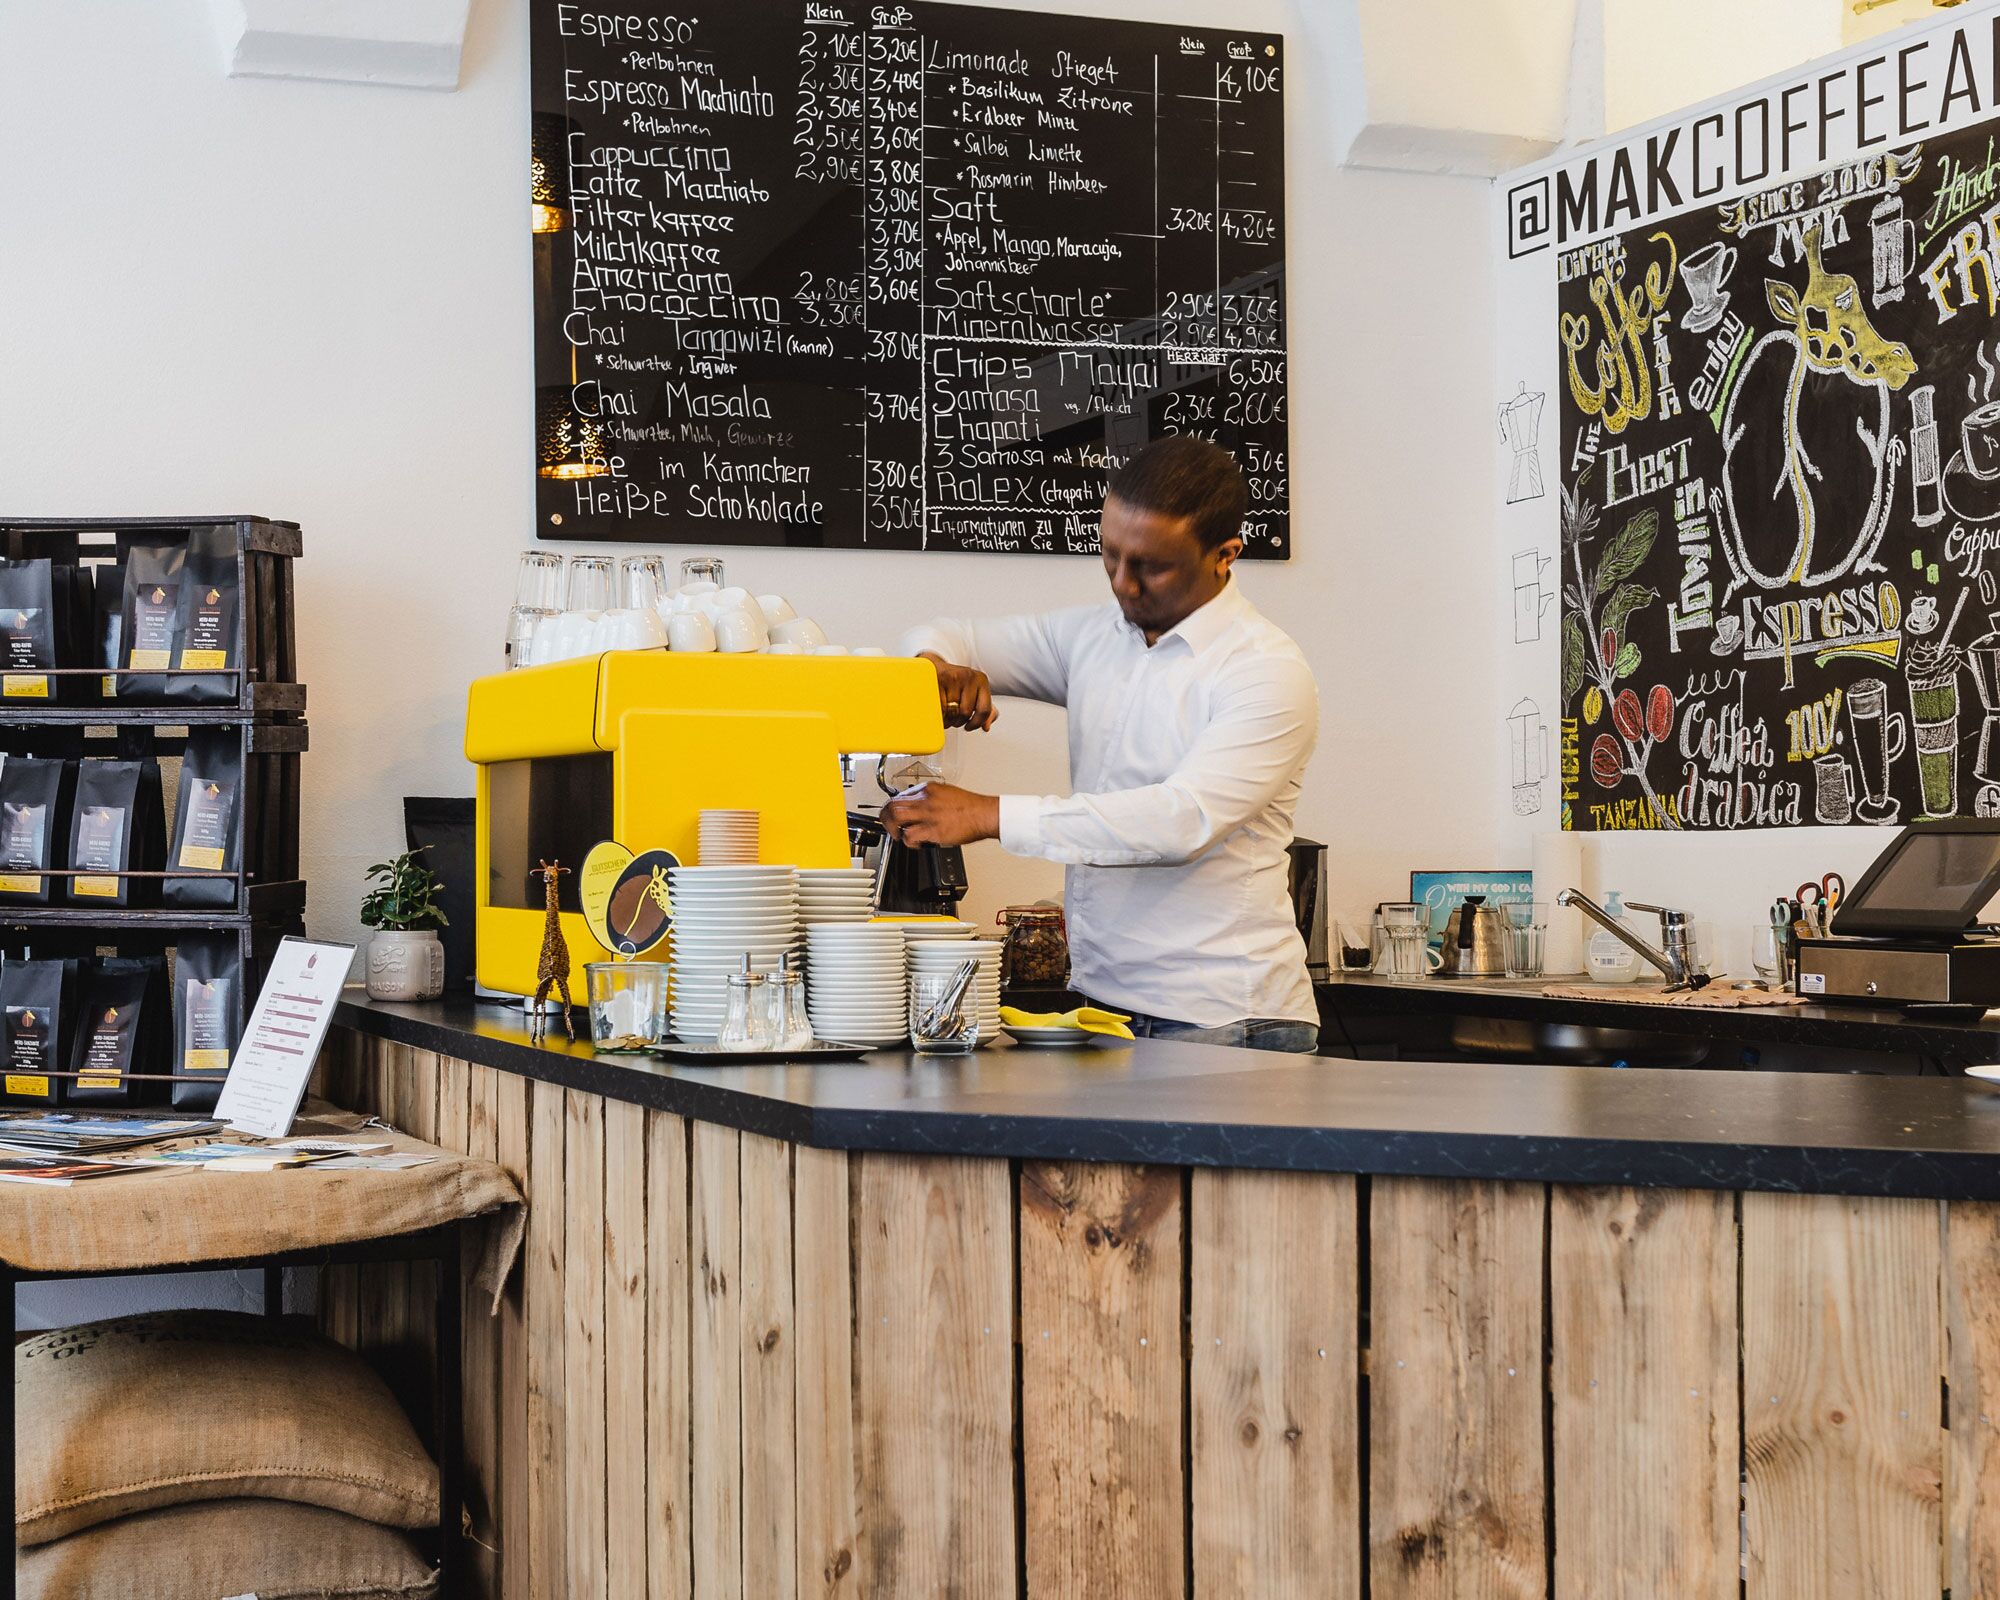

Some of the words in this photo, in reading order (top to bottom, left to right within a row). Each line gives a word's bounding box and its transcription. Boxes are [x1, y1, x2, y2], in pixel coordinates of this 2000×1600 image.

[806, 2, 844, 20] Klein
[798, 31, 862, 59] 2,10€
[868, 36, 920, 64] 3,20€
[928, 39, 1029, 77] Limonade
[1179, 36, 1206, 50] Klein
[566, 69, 670, 114] Espresso
[798, 59, 864, 92] 2,30€
[868, 67, 922, 93] 3,40€
[1218, 65, 1280, 98] 4,10€
[796, 90, 864, 120] 2,30€
[868, 96, 919, 122] 3,40€
[1056, 86, 1134, 116] Zitrone
[793, 118, 863, 151] 2,50€
[870, 125, 922, 154] 3,60€
[1028, 138, 1084, 163] Limette
[1508, 16, 2000, 260] @MAKCOFFEEA
[568, 133, 732, 173] Cappuccino
[795, 151, 863, 184] 2,90€
[569, 166, 643, 199] Latte
[664, 170, 770, 204] Macchiato
[868, 159, 922, 186] 3,80€
[1048, 170, 1108, 195] Himbeer
[1818, 157, 1883, 204] 2016
[868, 188, 921, 217] 3,90€
[931, 187, 1004, 224] Saft
[871, 218, 922, 247] 3,70€
[1166, 207, 1214, 232] 3,20€
[574, 229, 721, 272] Milchkaffee
[868, 248, 923, 277] 3,90€
[944, 251, 1040, 275] Johannisbeer
[573, 258, 732, 296] Americano
[794, 271, 863, 301] 2,80€
[868, 275, 920, 304] 3,60€
[573, 288, 780, 322] Chococcino
[1161, 291, 1217, 320] 2,90€
[563, 312, 625, 346] Chai
[936, 309, 1124, 344] Mineralwasser
[1224, 326, 1282, 349] 4,90€
[867, 329, 921, 363] 3,80€
[688, 354, 738, 379] Ingwer
[1228, 358, 1285, 391] 6,50€
[571, 379, 638, 417] Chai
[666, 380, 772, 419] Masala
[867, 392, 922, 423] 3,70€
[1163, 392, 1216, 424] 2,30€
[1223, 391, 1287, 427] 2,60€
[934, 411, 1044, 452] Chapati
[570, 441, 628, 478] Tee
[659, 455, 685, 481] im
[703, 451, 811, 484] Kännchen
[932, 443, 955, 469] 3
[959, 443, 1045, 469] Samosa
[1053, 447, 1073, 464] mit
[867, 459, 923, 492] 3,80€
[575, 481, 670, 519] Heiße
[686, 484, 824, 527] Schokolade
[867, 493, 923, 532] 3,50€
[930, 511, 1027, 540] Informationen
[961, 533, 1020, 551] erhalten
[1031, 534, 1054, 551] Sie
[1066, 535, 1102, 553] beim
[1742, 580, 1902, 692] Espresso
[1785, 687, 1845, 764] 100%
